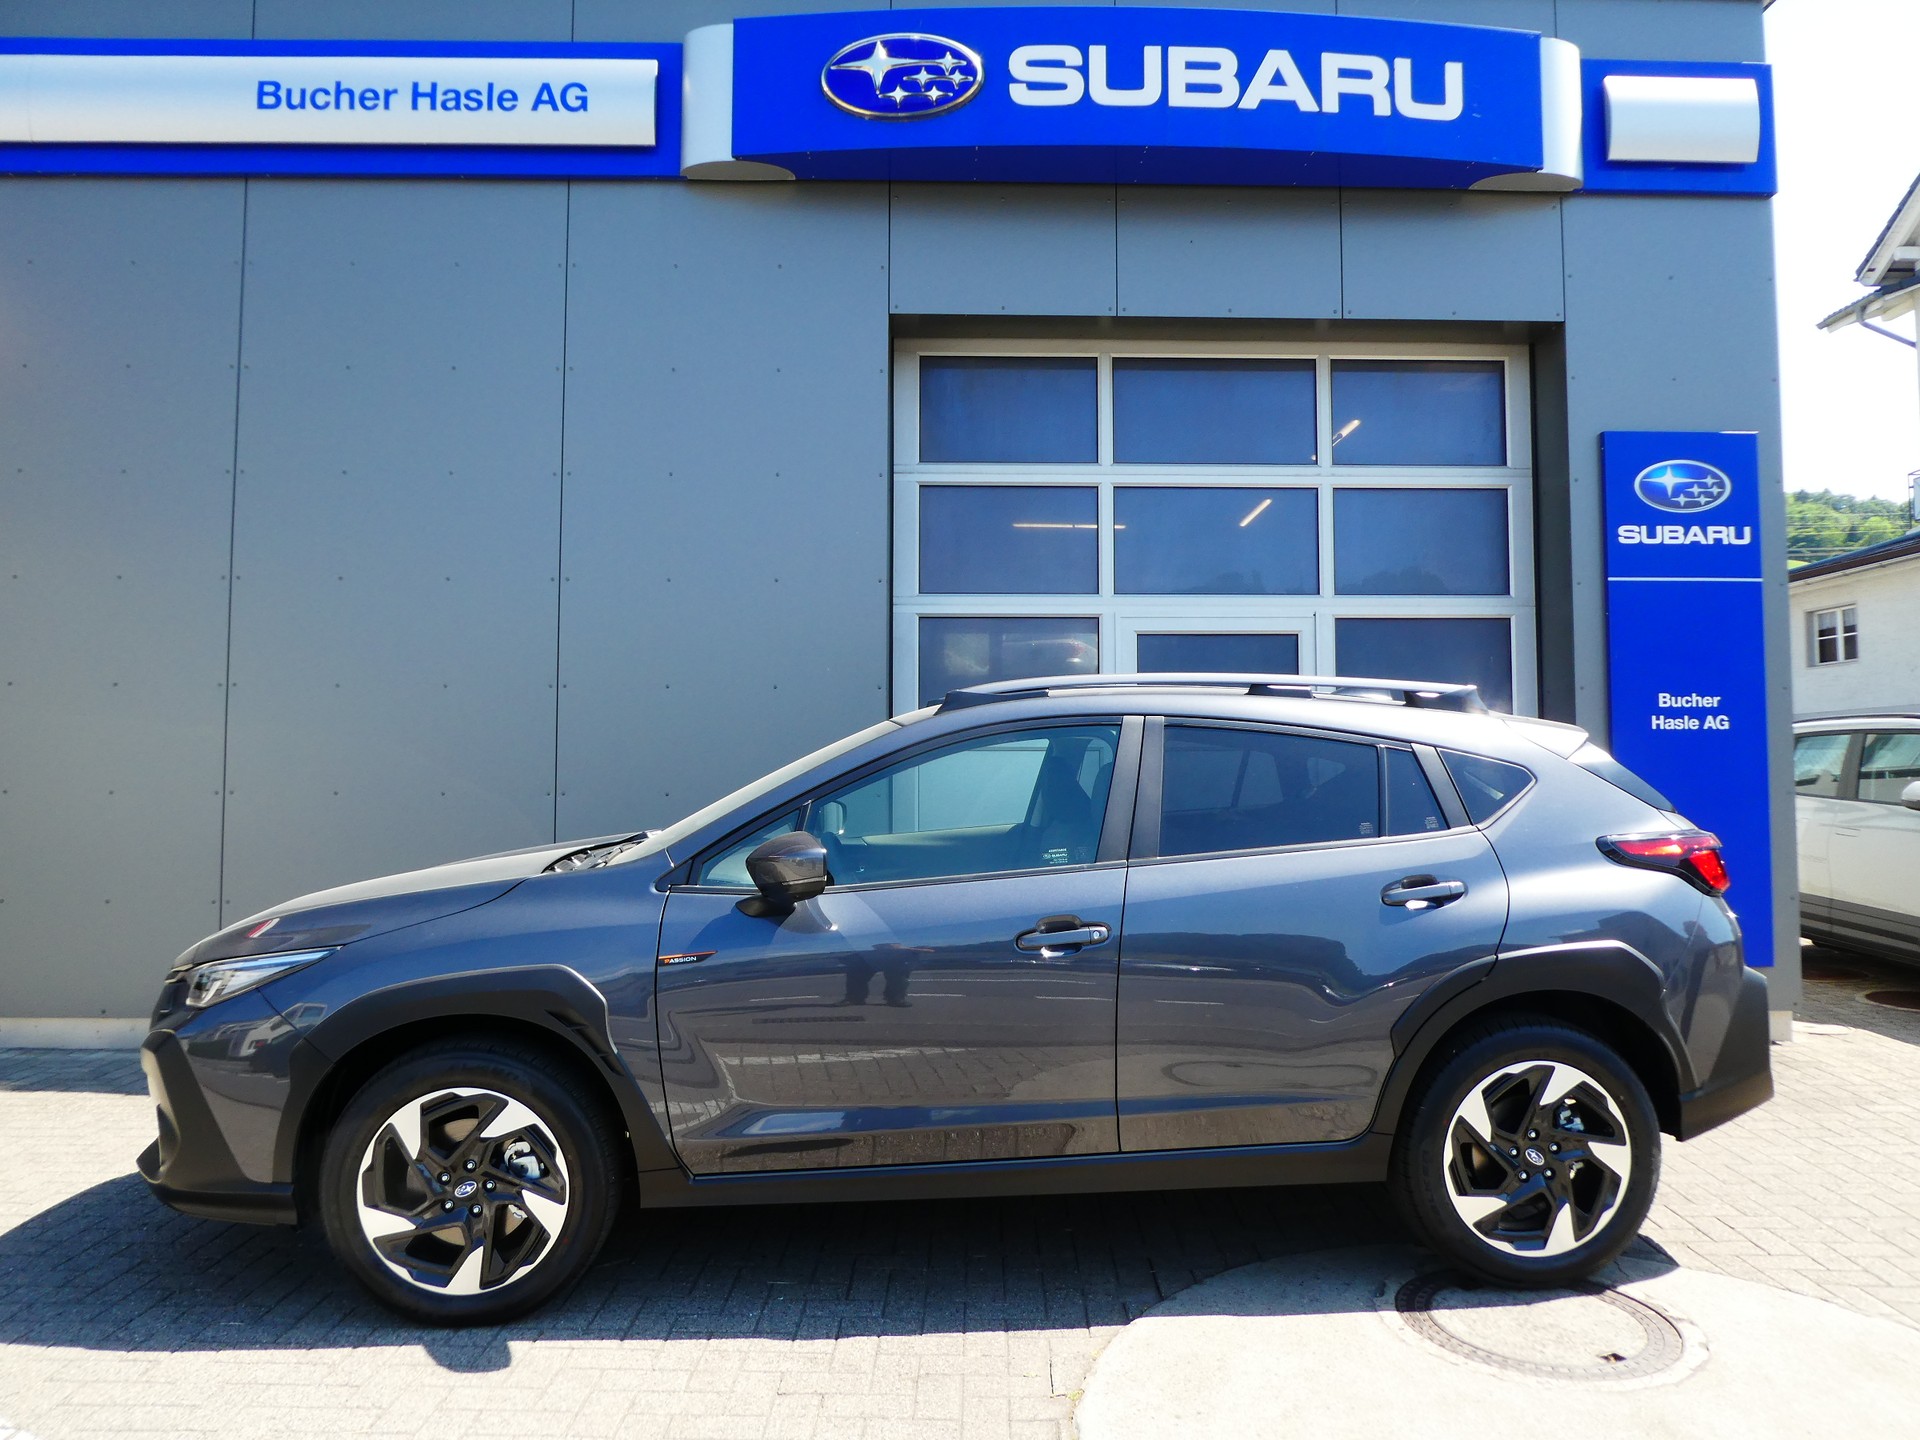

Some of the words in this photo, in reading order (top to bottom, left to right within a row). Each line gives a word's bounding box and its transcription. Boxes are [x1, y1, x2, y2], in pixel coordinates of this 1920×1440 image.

[1008, 44, 1464, 121] SUBARU
[257, 80, 398, 111] Bucher
[411, 81, 519, 112] Hasle
[532, 82, 589, 112] AG
[1617, 525, 1752, 545] SUBARU
[1658, 693, 1721, 708] Bucher
[1651, 715, 1699, 730] Hasle
[1703, 715, 1730, 730] AG
[665, 956, 697, 964] PASSION
